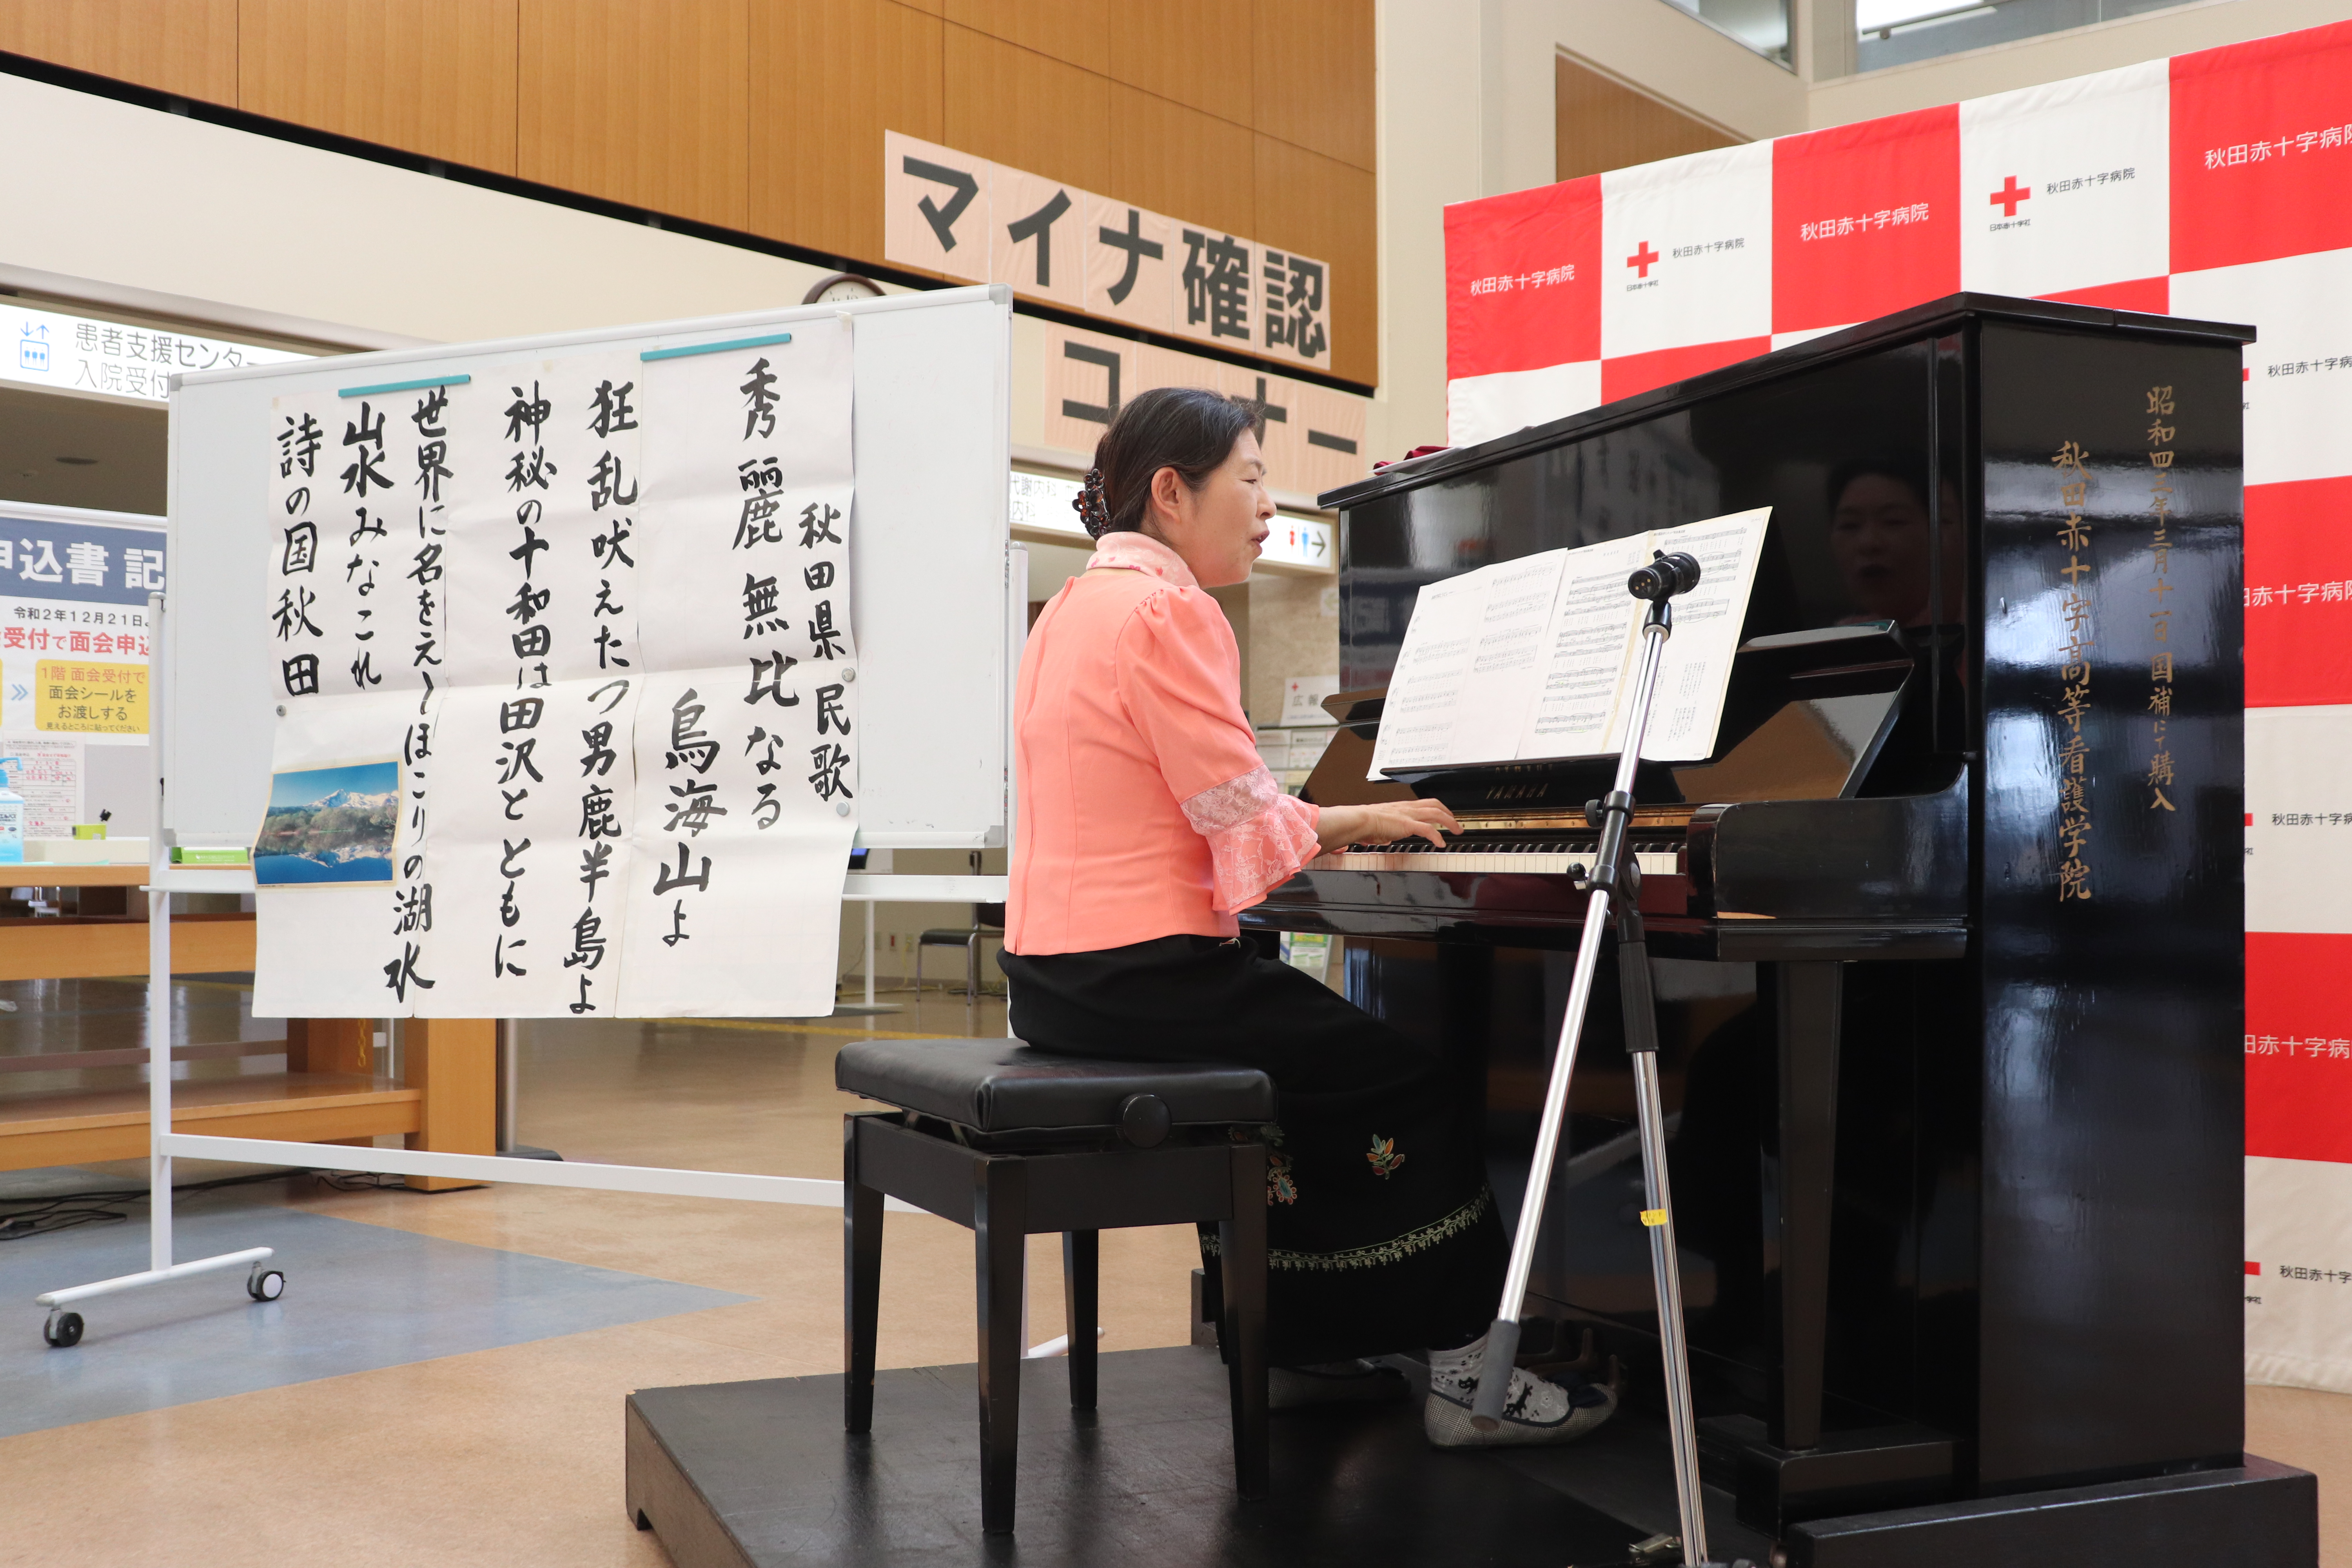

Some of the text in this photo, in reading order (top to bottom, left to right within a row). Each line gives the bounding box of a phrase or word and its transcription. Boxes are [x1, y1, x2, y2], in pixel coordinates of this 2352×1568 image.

[2047, 167, 2135, 194] 秋田赤十字病院
[1800, 202, 1929, 241] 秋田赤十字病院
[1989, 218, 2031, 232] 日本赤十字社
[903, 154, 1327, 359] マイナ確認
[1672, 237, 1745, 259] 秋田赤十字病院
[1470, 264, 1575, 296] 秋田赤十字病院
[75, 359, 169, 399] 入院受付
[1062, 340, 1357, 455] コナー
[1010, 499, 1036, 523] 内科
[272, 412, 323, 697] 詩の国秋田
[340, 401, 394, 690] 山水みなこれ
[14, 606, 149, 627] 令和2年12月21日
[0, 627, 149, 656] 受付で面会申込
[798, 503, 853, 802] 秋田県民歌
[42, 666, 145, 684] 1階 面会受付で
[495, 380, 557, 978] 神秘の十和田は田沢とともに
[49, 685, 136, 702] 面会シールを
[58, 704, 127, 720] お渡しする
[46, 722, 140, 732] 見えるところに貼ってください
[1486, 783, 1548, 799] YAMAHA
[2245, 1034, 2352, 1059] 田赤十字病
[2280, 1265, 2352, 1284] 秋田赤十字
